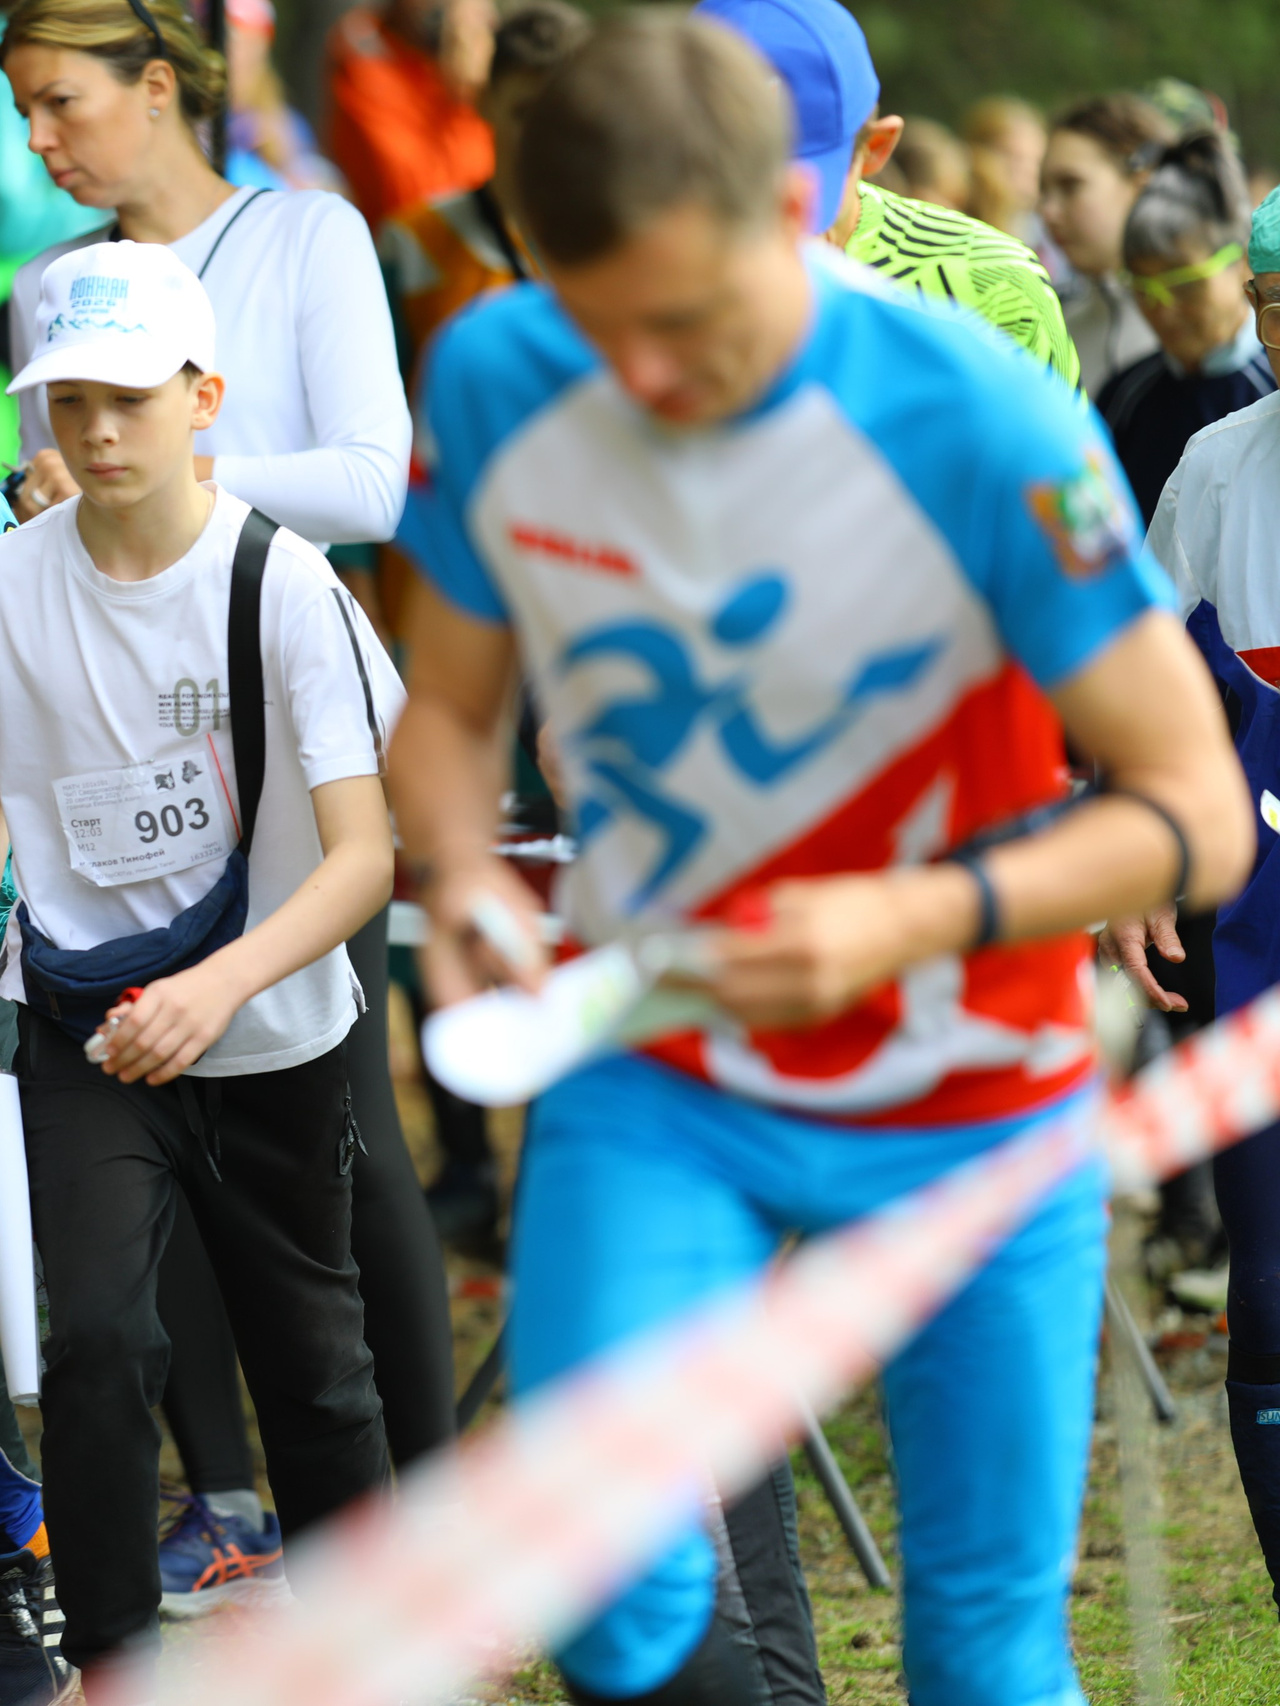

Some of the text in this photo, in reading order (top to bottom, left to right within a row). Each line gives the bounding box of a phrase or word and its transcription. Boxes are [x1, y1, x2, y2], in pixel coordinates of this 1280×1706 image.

[71, 817, 100, 828] Старт
[135, 798, 210, 844] 903
[74, 827, 102, 839] 12:03
[120, 849, 166, 865] Тимофей
